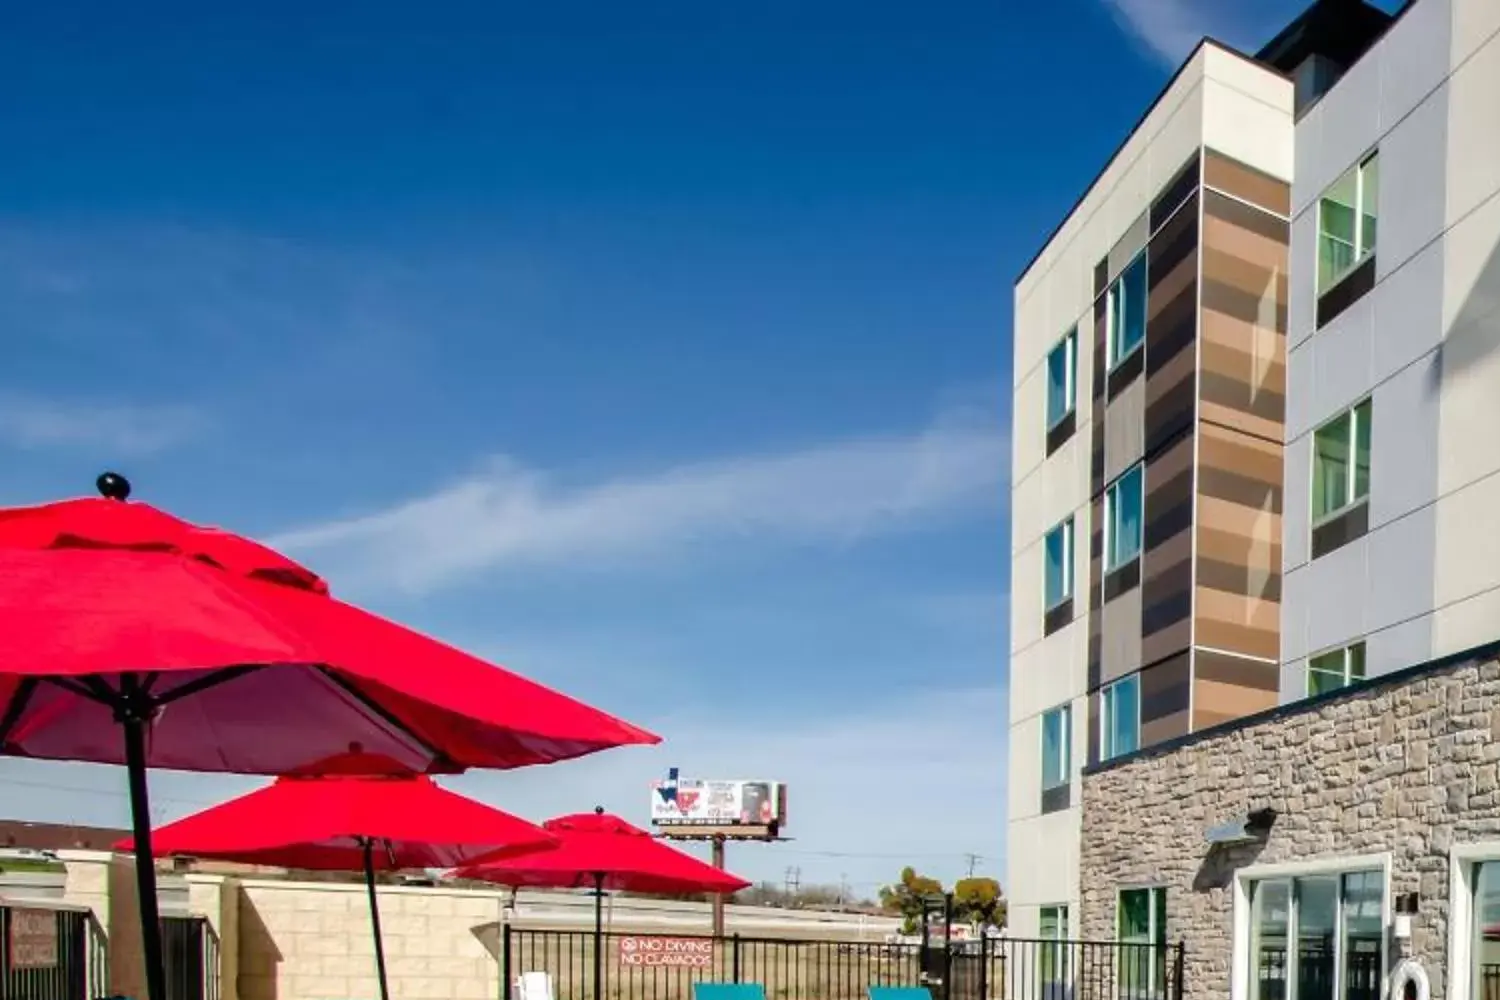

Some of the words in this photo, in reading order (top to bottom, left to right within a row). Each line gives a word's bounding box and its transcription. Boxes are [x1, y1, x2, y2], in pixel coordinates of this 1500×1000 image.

[640, 939, 661, 951] NO
[665, 940, 712, 953] DIVING
[621, 953, 642, 965] NO
